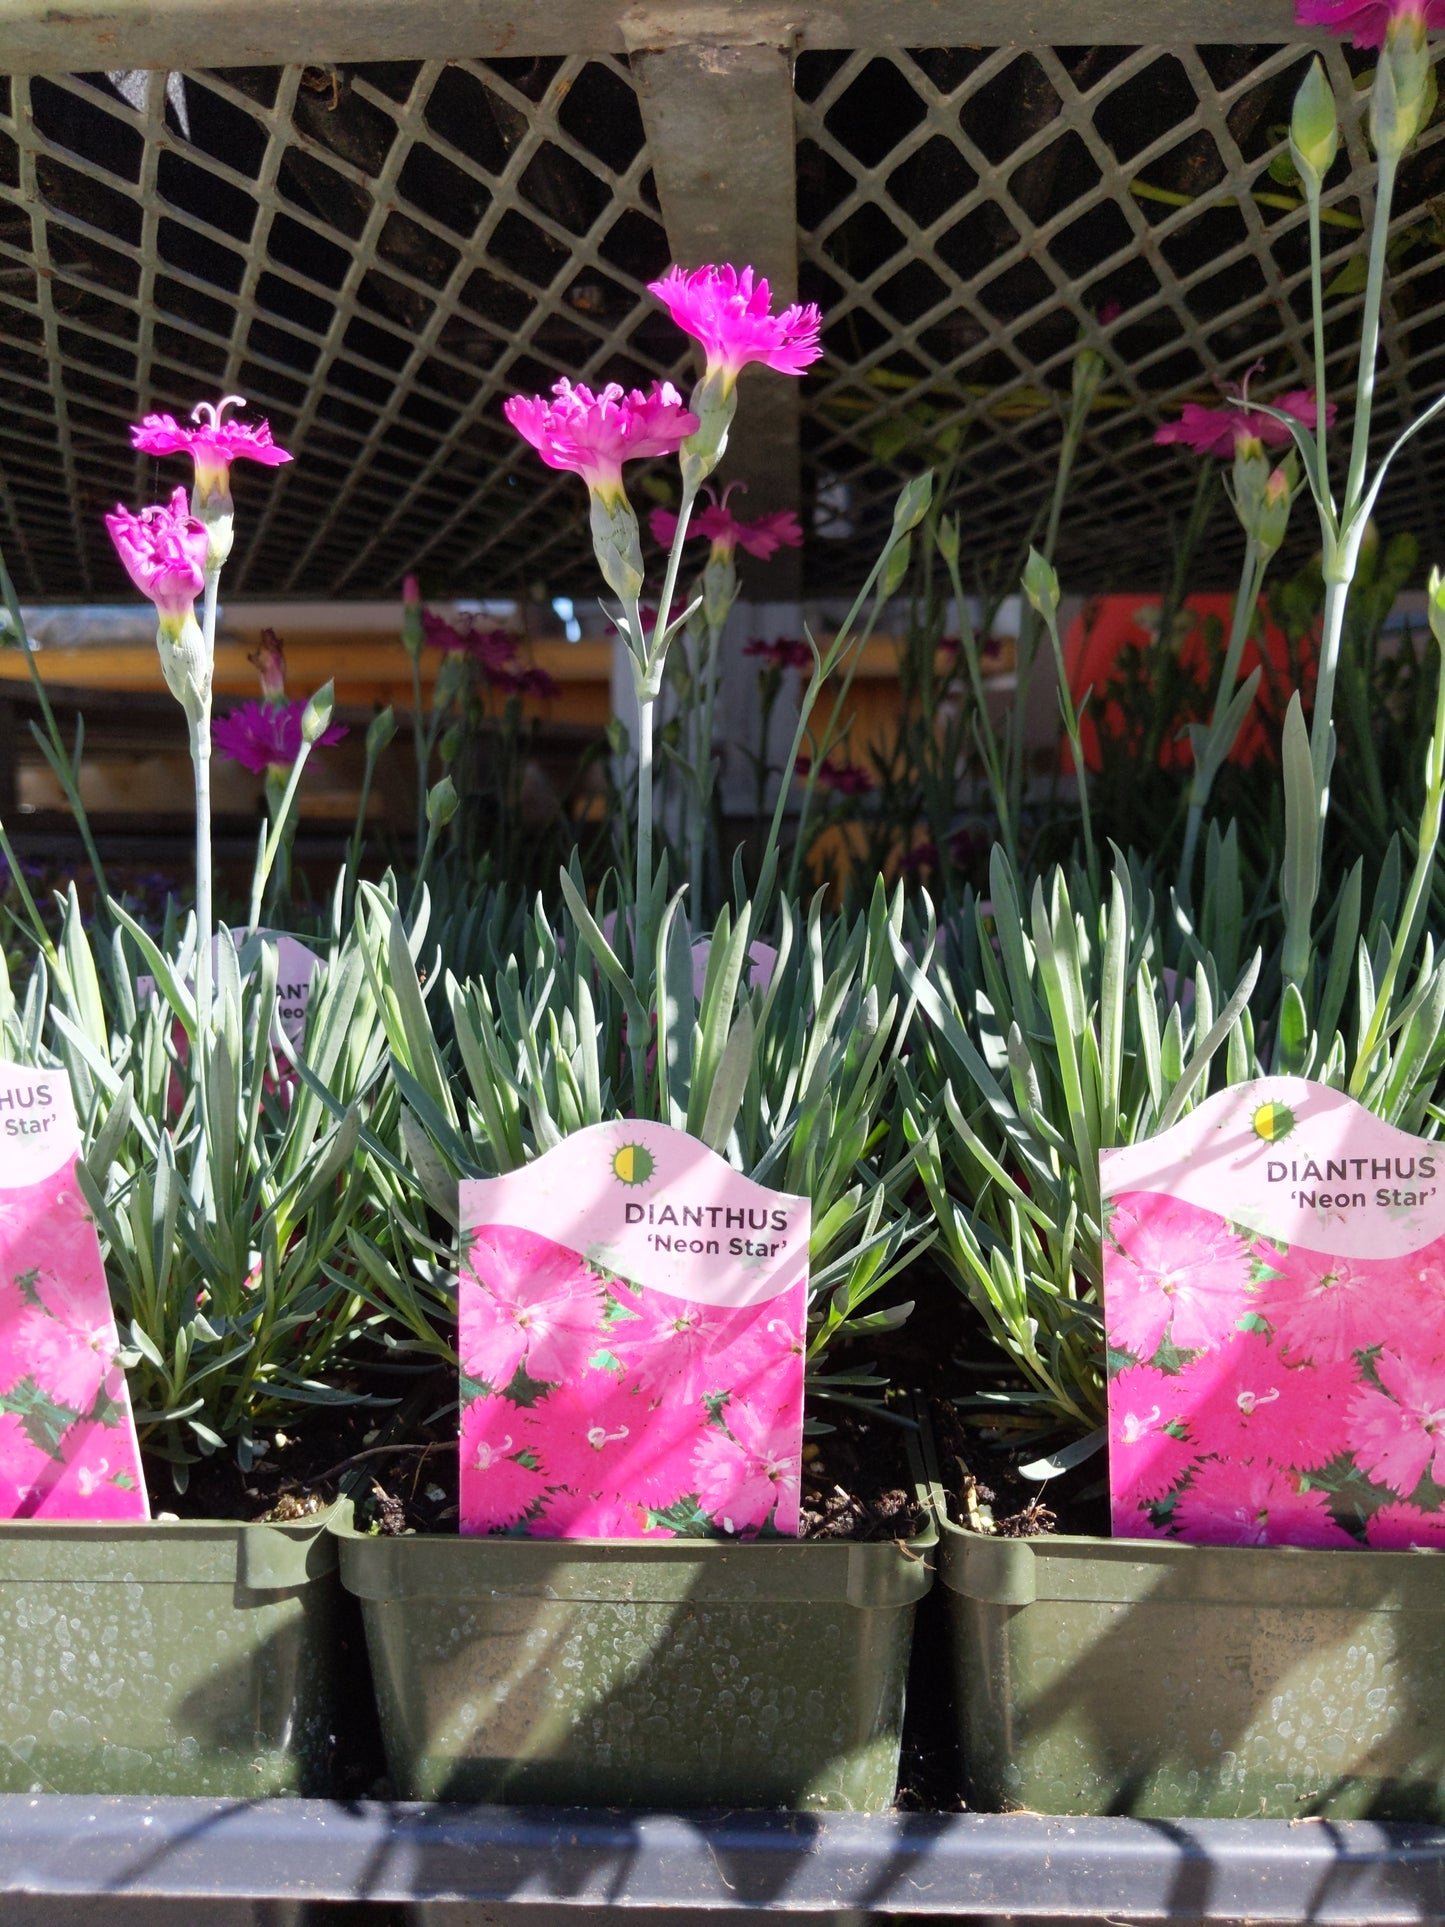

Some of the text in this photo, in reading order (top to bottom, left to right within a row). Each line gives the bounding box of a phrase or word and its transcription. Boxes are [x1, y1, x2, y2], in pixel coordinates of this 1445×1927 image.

[1267, 1157, 1436, 1182] DIANTHUS
[1291, 1187, 1437, 1208] ‘Neon Star’
[625, 1203, 788, 1231] DIANTHUS
[647, 1234, 787, 1257] ‘Neon Star’
